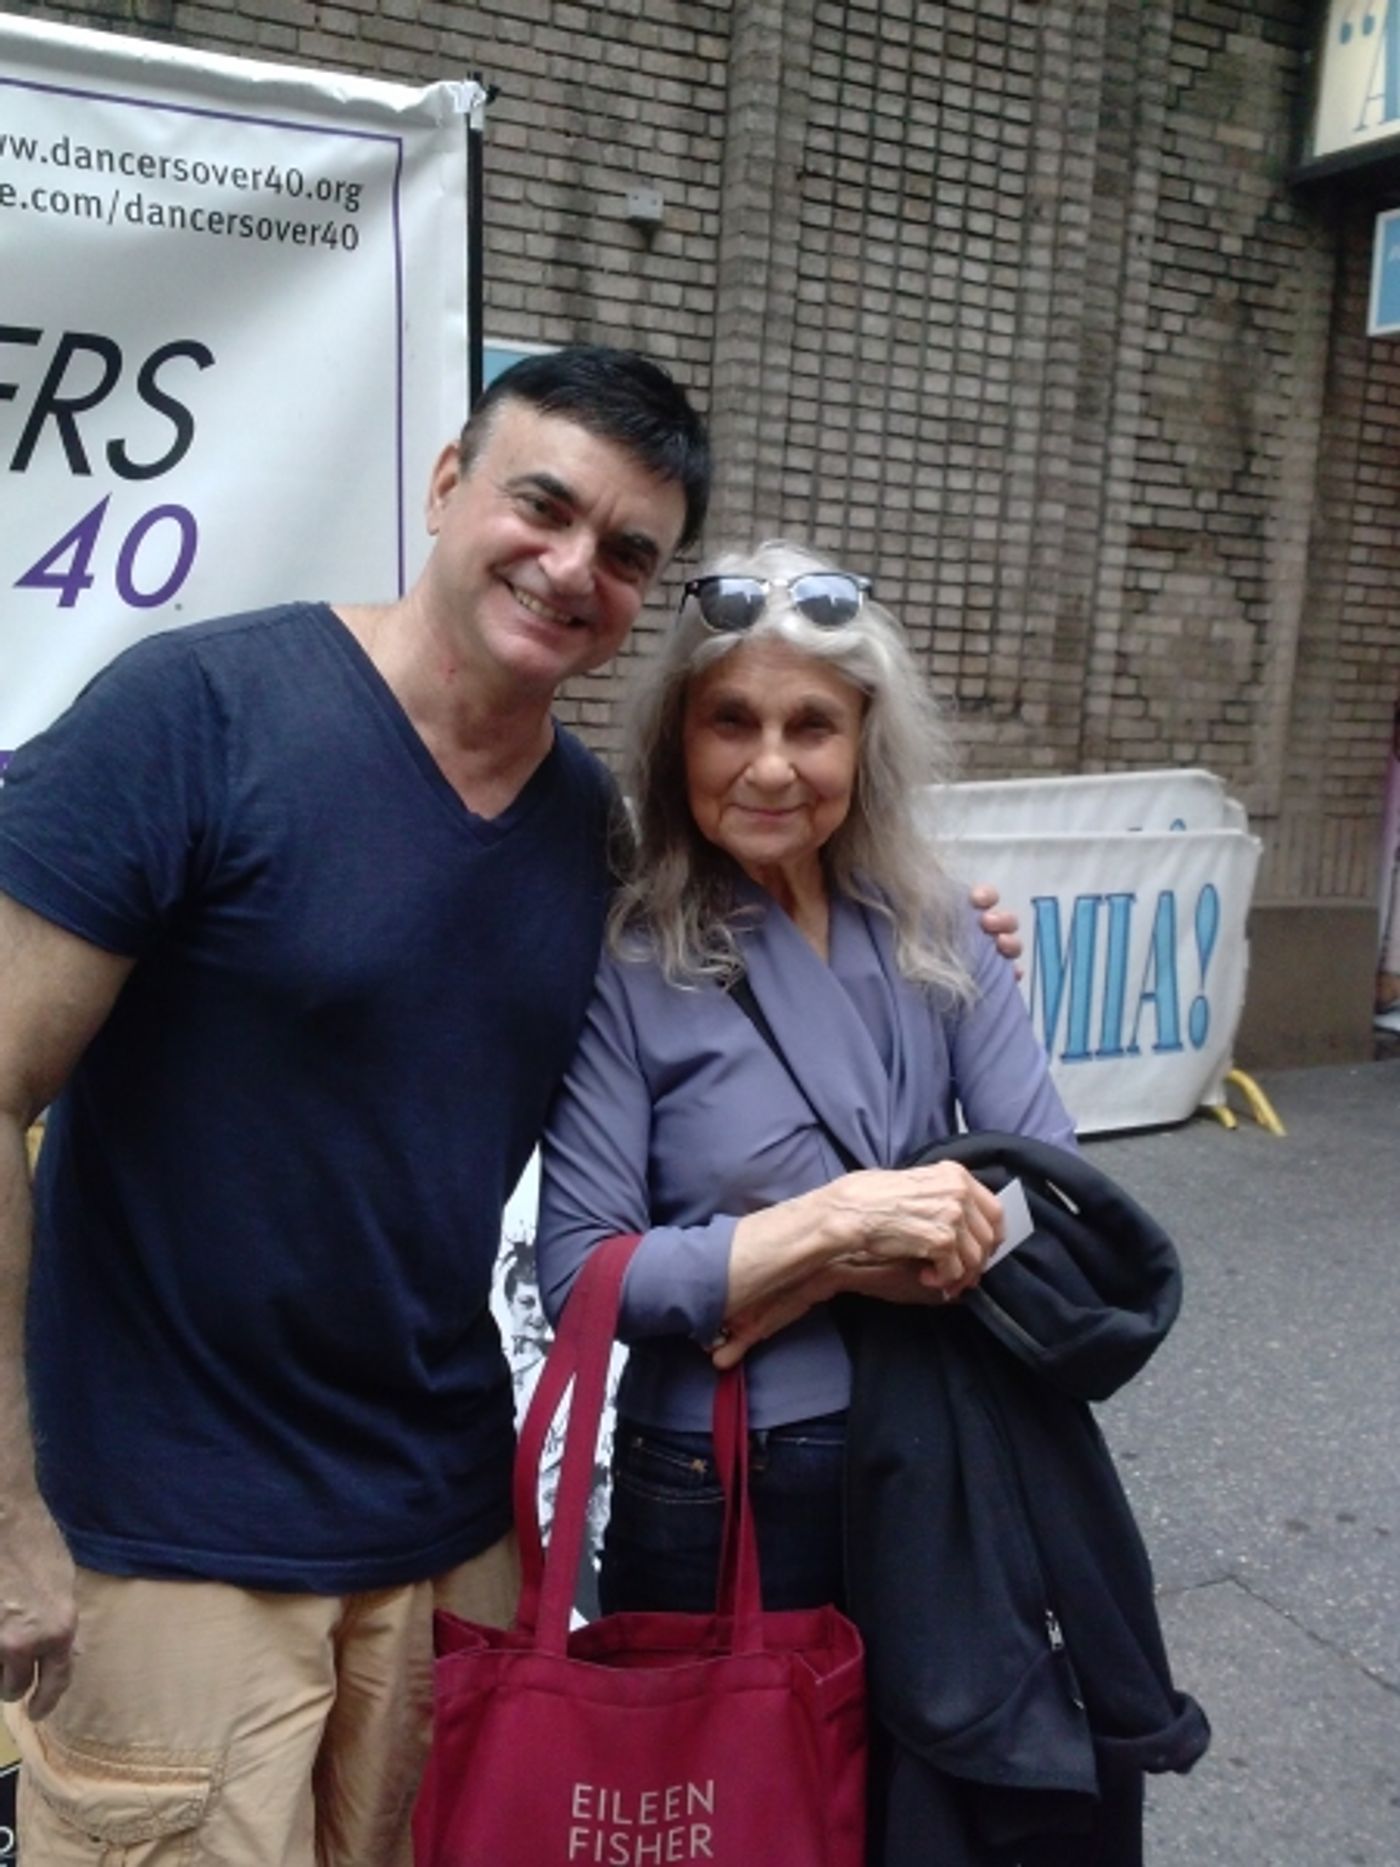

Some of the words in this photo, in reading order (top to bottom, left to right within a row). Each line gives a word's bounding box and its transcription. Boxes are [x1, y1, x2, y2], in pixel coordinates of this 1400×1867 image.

[1030, 883, 1221, 1065] MIA!
[571, 1779, 714, 1825] EILEEN
[568, 1823, 714, 1867] FISHER
